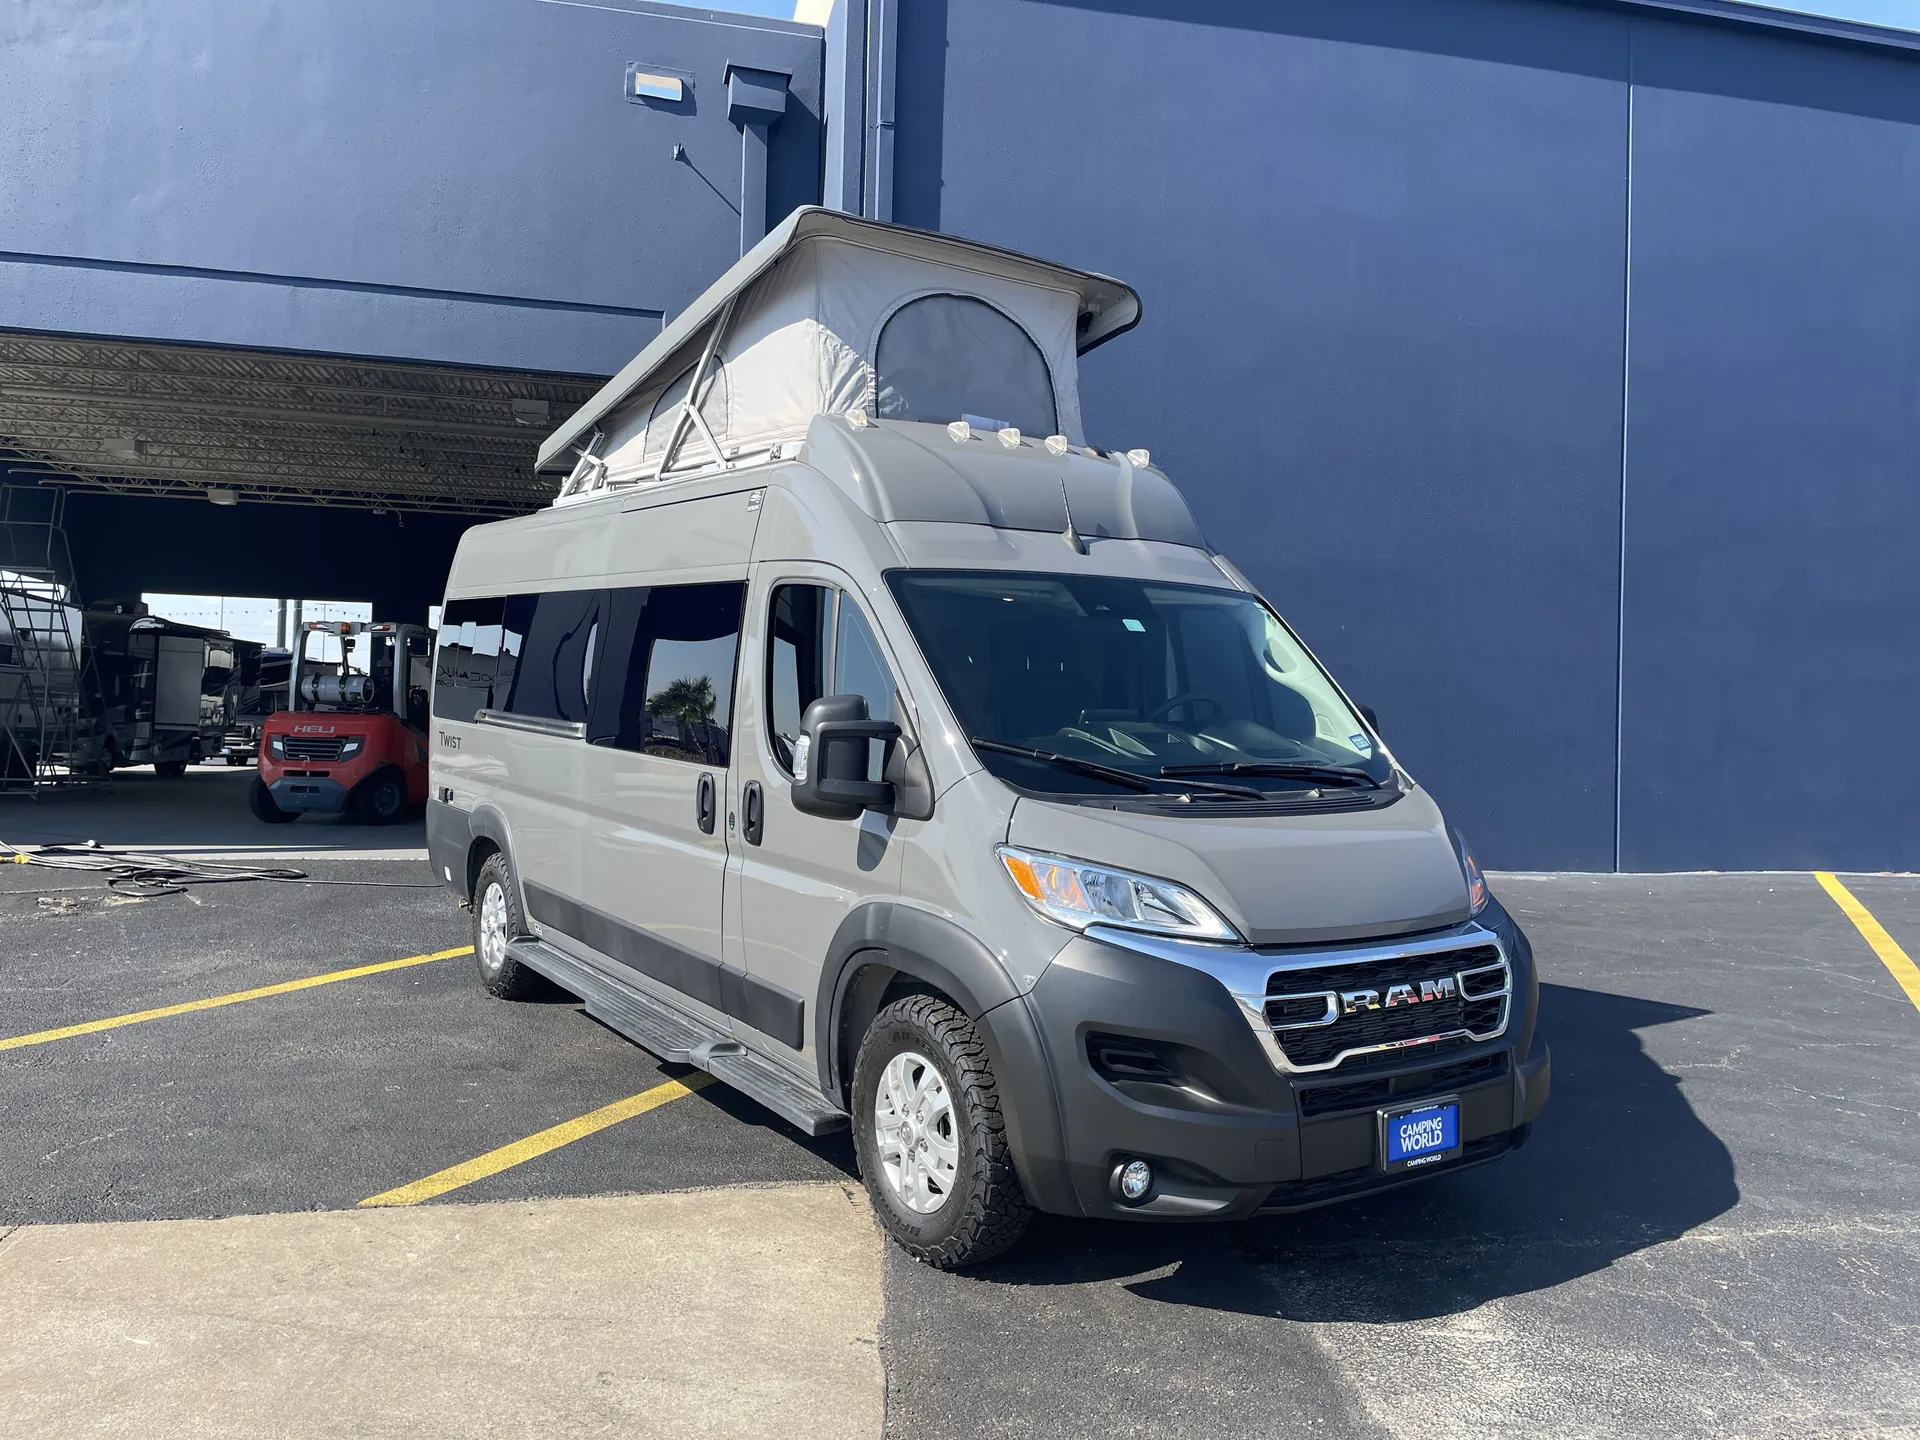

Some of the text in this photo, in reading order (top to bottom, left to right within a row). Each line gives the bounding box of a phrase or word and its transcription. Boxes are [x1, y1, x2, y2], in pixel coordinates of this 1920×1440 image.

[293, 725, 336, 734] HELI
[438, 730, 462, 750] TWIST
[1340, 977, 1456, 1014] RAM
[1400, 1117, 1442, 1138] CAMPING
[1400, 1130, 1443, 1153] WORLD
[1407, 1154, 1442, 1167] CAMPING WORLD
